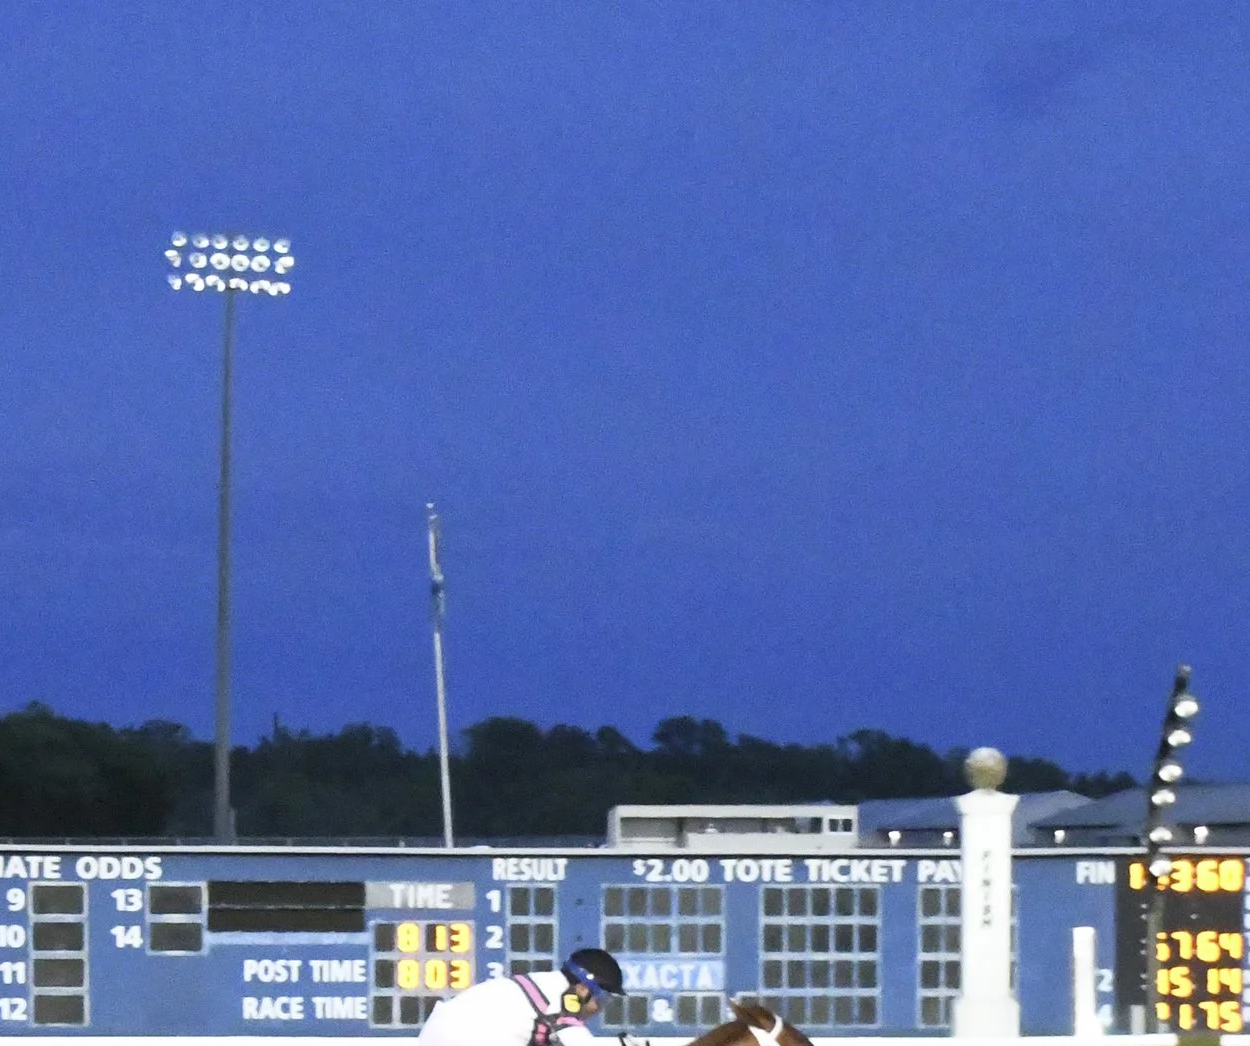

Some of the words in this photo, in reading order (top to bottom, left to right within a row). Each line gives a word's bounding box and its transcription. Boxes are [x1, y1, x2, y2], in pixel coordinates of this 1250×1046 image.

[75, 856, 163, 883] ODDS
[492, 857, 568, 885] RESULT
[632, 858, 710, 883] $2.00
[719, 858, 793, 883] TOTE
[804, 858, 907, 885] TICKET
[1076, 861, 1116, 884] FIN
[6, 887, 26, 912] 9
[110, 888, 144, 912] 13
[388, 882, 455, 910] TIME
[486, 889, 501, 913] 1
[110, 925, 144, 949] 14
[485, 925, 504, 949] 2
[243, 959, 303, 983] POST
[309, 959, 367, 983] TIME
[622, 963, 715, 990] XACTA
[242, 996, 305, 1020] RACE
[311, 996, 368, 1020] TIME
[651, 998, 675, 1023] &
